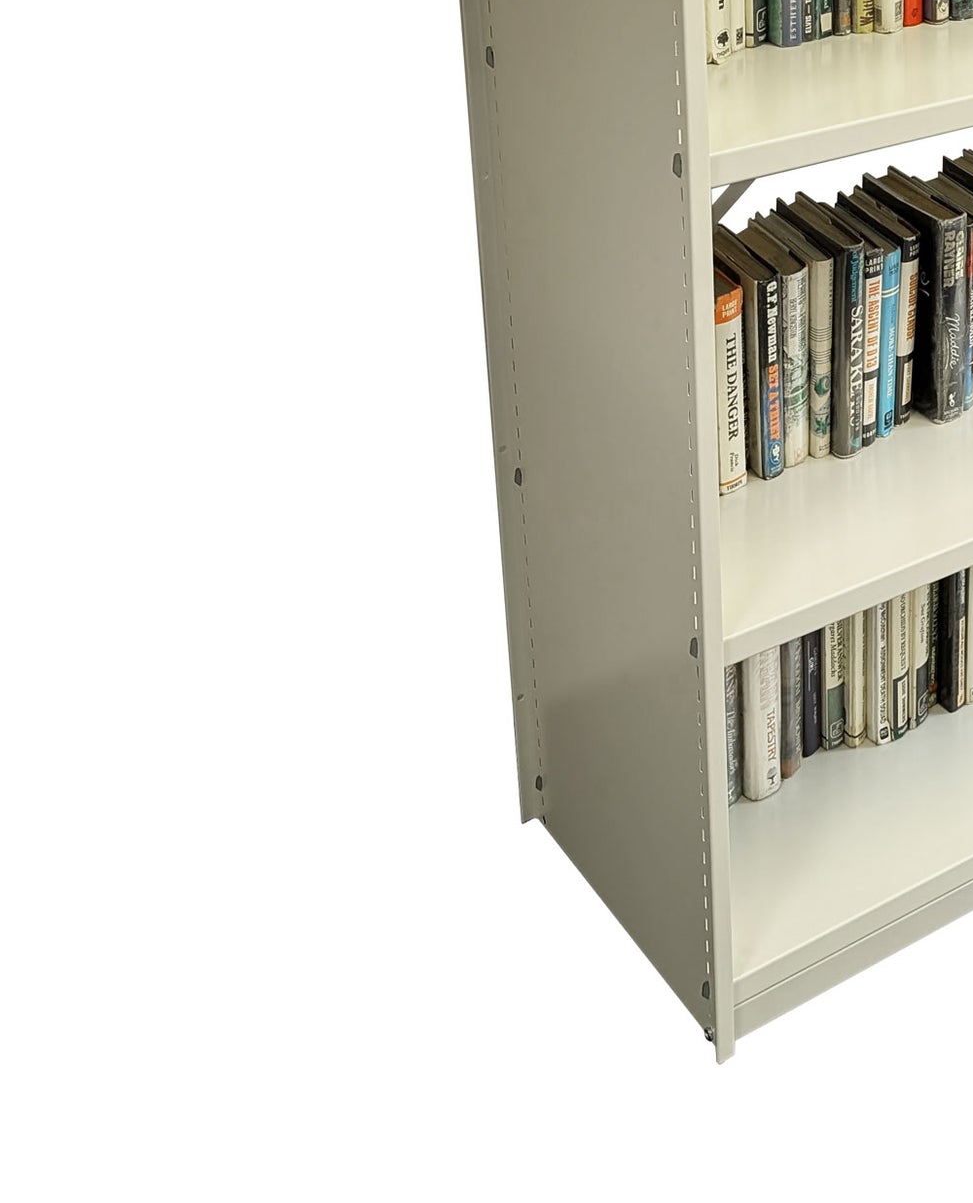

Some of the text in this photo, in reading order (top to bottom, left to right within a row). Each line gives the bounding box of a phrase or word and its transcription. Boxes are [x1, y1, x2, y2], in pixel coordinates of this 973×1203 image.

[850, 259, 859, 303] Judgement
[943, 231, 956, 287] RAYNER
[850, 305, 863, 360] SARA
[867, 280, 880, 349] THE ASCENT OF
[887, 326, 895, 351] MORE
[946, 313, 961, 370] Maddie
[725, 333, 738, 441] THE DANGER
[767, 364, 780, 439] SET THIEF
[830, 644, 838, 677] Maddocks
[766, 708, 777, 761] TAPESTRY
